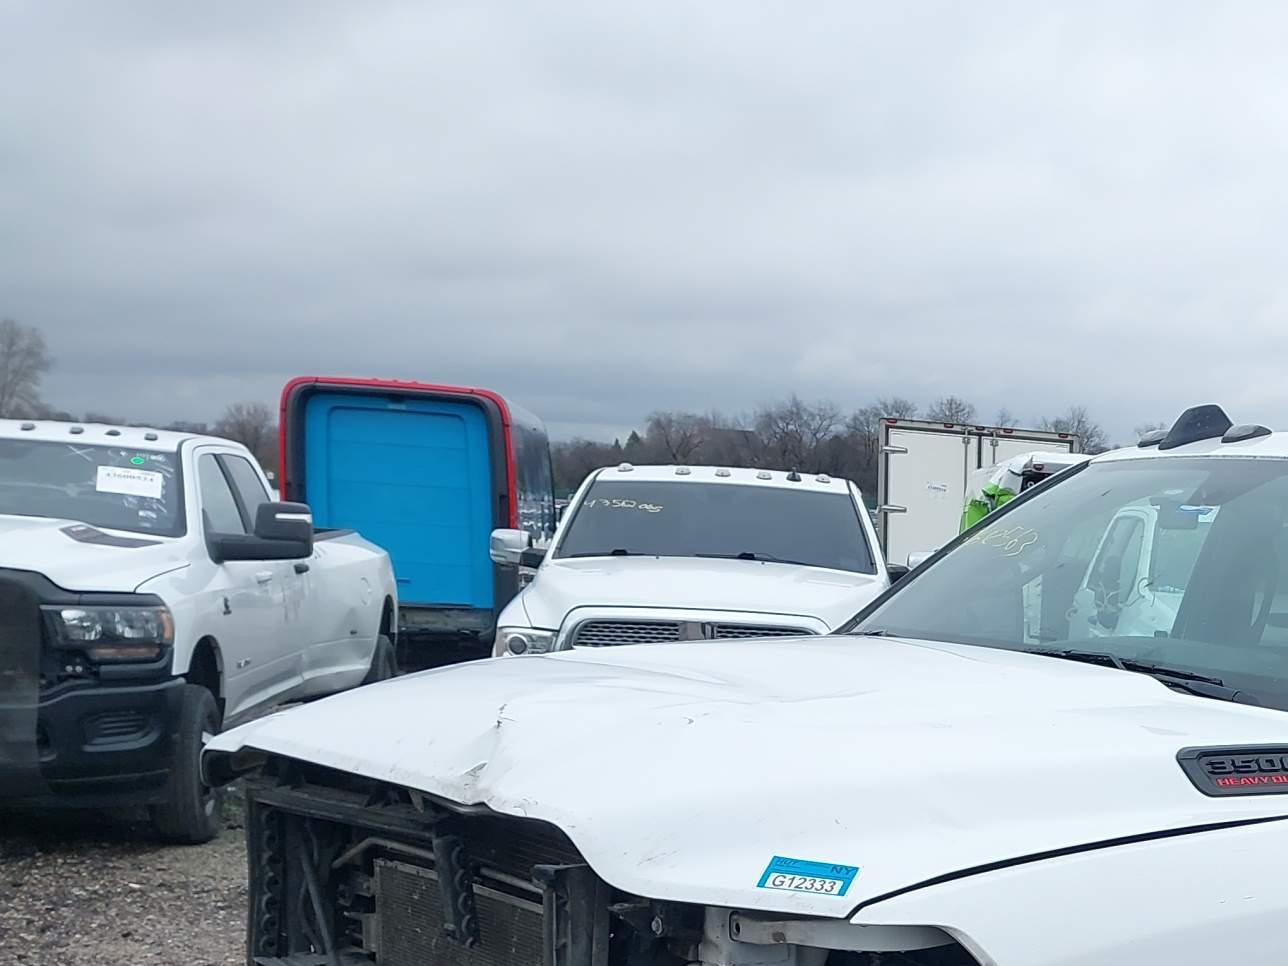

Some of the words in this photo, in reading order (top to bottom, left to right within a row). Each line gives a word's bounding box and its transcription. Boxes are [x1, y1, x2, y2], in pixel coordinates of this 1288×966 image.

[1216, 777, 1269, 787] HEAVY
[831, 866, 854, 875] NY
[772, 875, 837, 892] G12333
